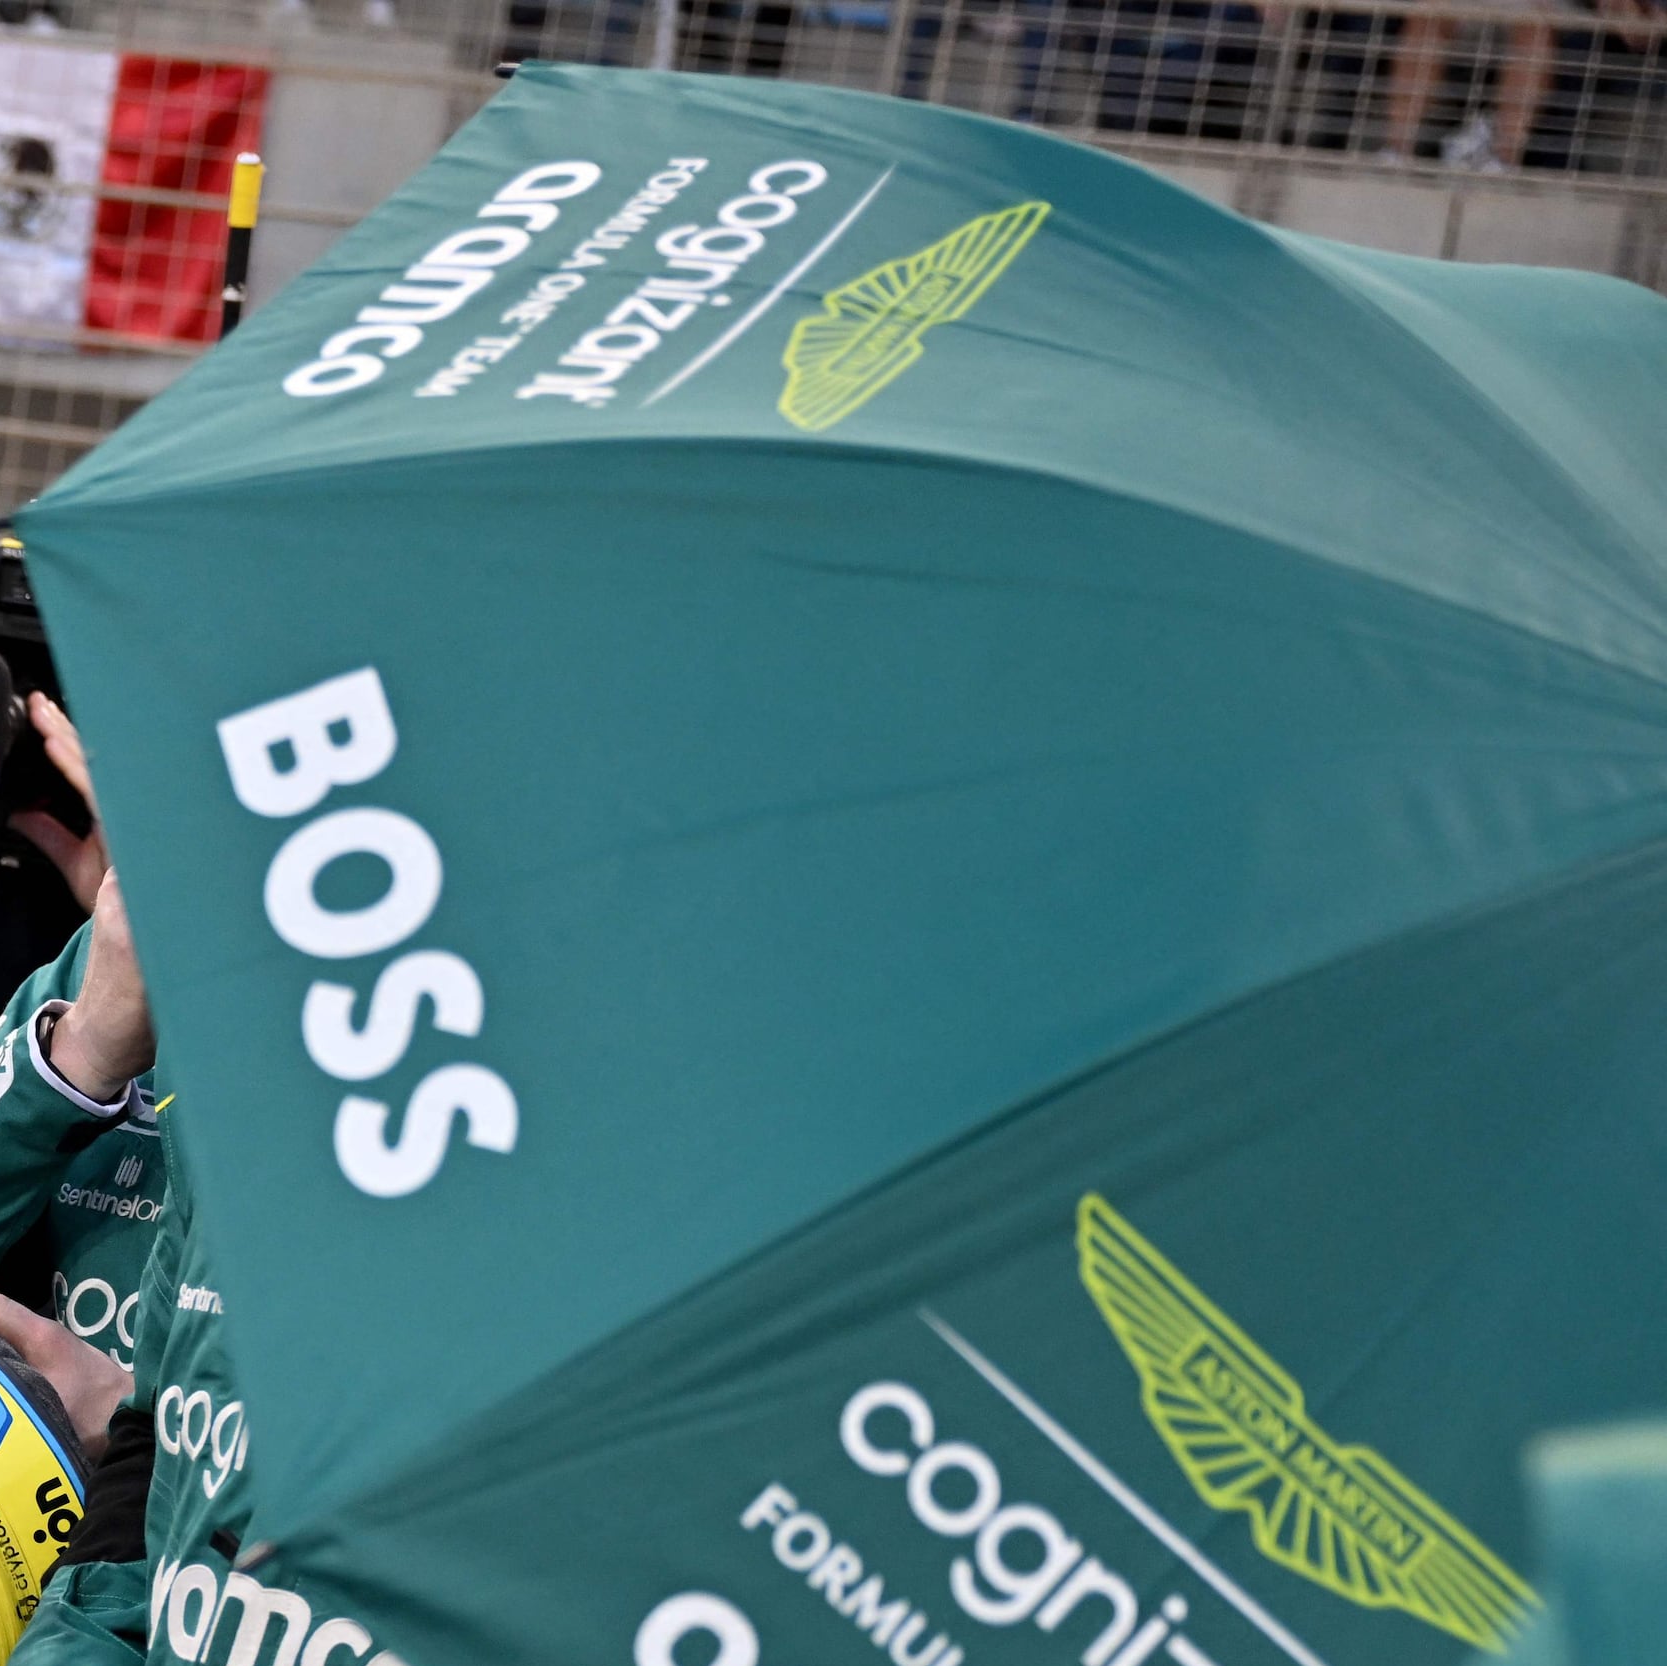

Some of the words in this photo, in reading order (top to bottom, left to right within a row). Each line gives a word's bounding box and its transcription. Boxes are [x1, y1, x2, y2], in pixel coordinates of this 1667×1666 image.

[283, 160, 602, 397] aramco
[516, 160, 829, 408] cognizant
[217, 667, 523, 1200] BOSS
[1185, 1347, 1298, 1449] ASTON
[1286, 1432, 1421, 1567] MARTIN
